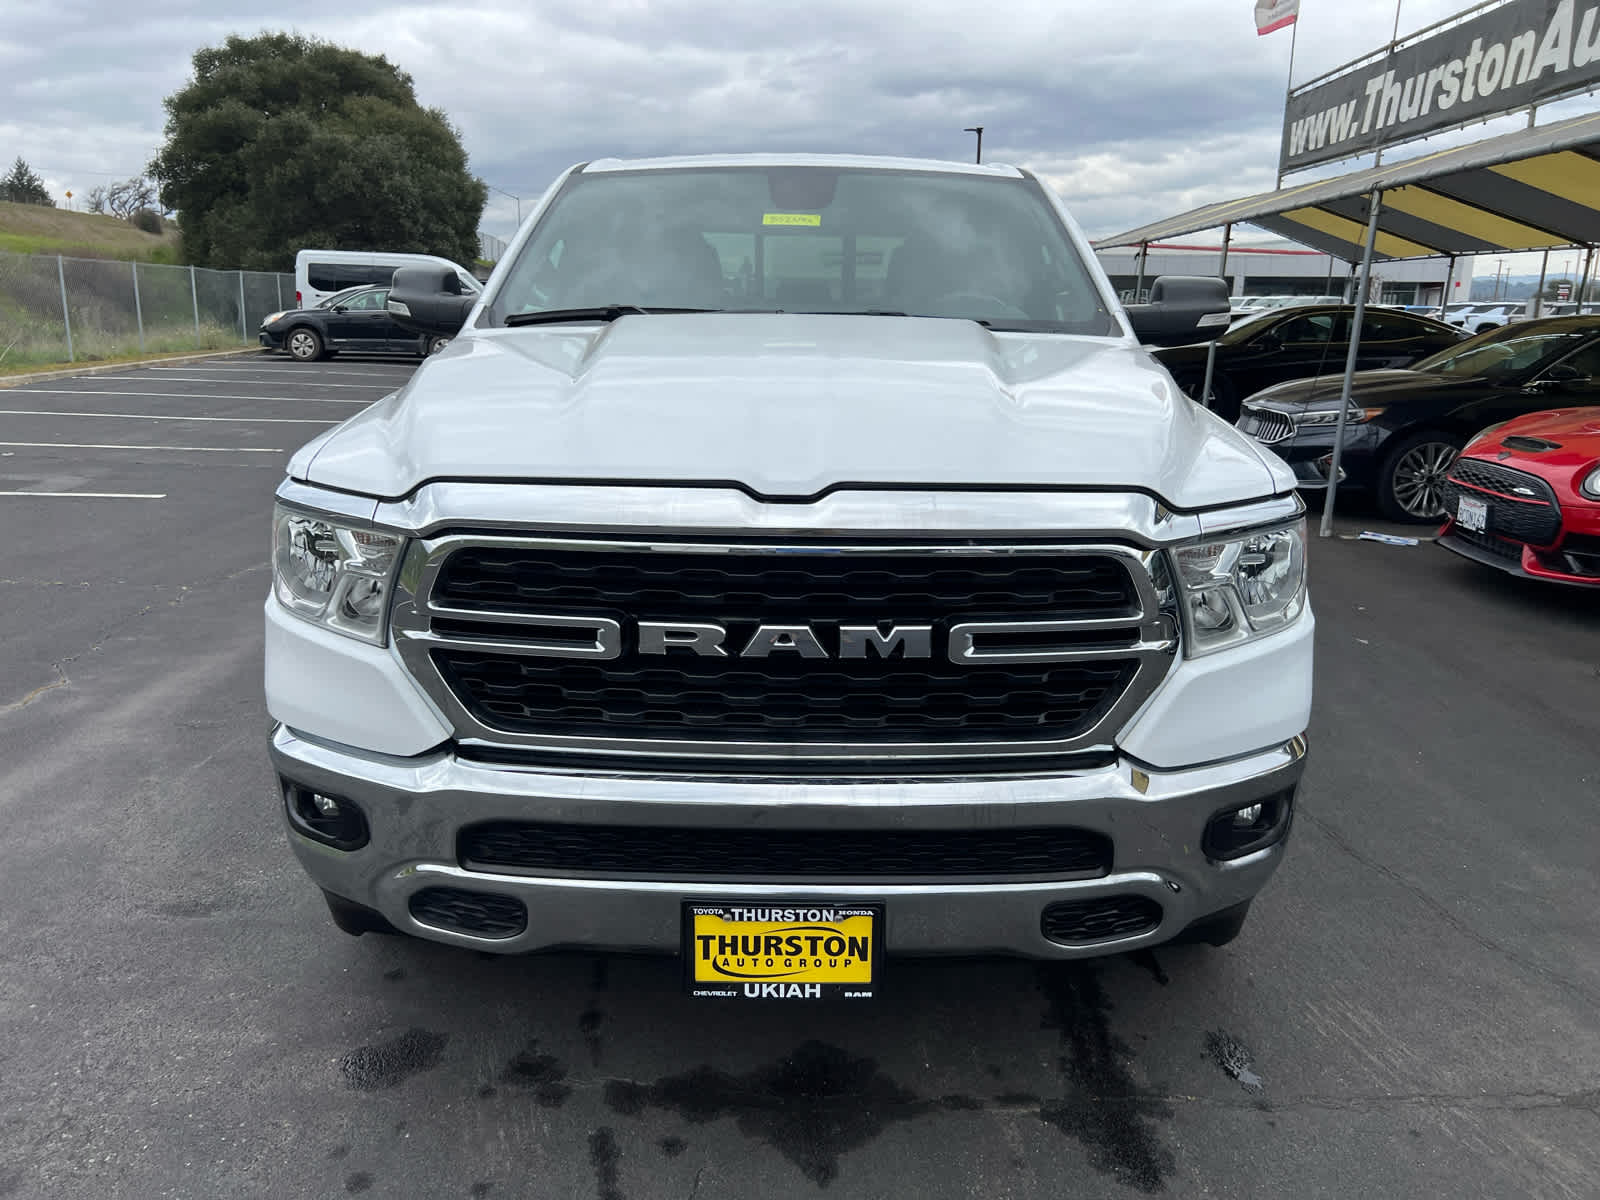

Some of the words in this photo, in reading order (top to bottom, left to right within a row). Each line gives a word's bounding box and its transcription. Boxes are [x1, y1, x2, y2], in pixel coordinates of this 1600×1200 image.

[638, 621, 932, 658] RAM
[730, 908, 834, 922] THURSTON
[696, 935, 869, 962] THURSTON
[744, 983, 821, 998] UKIAH
